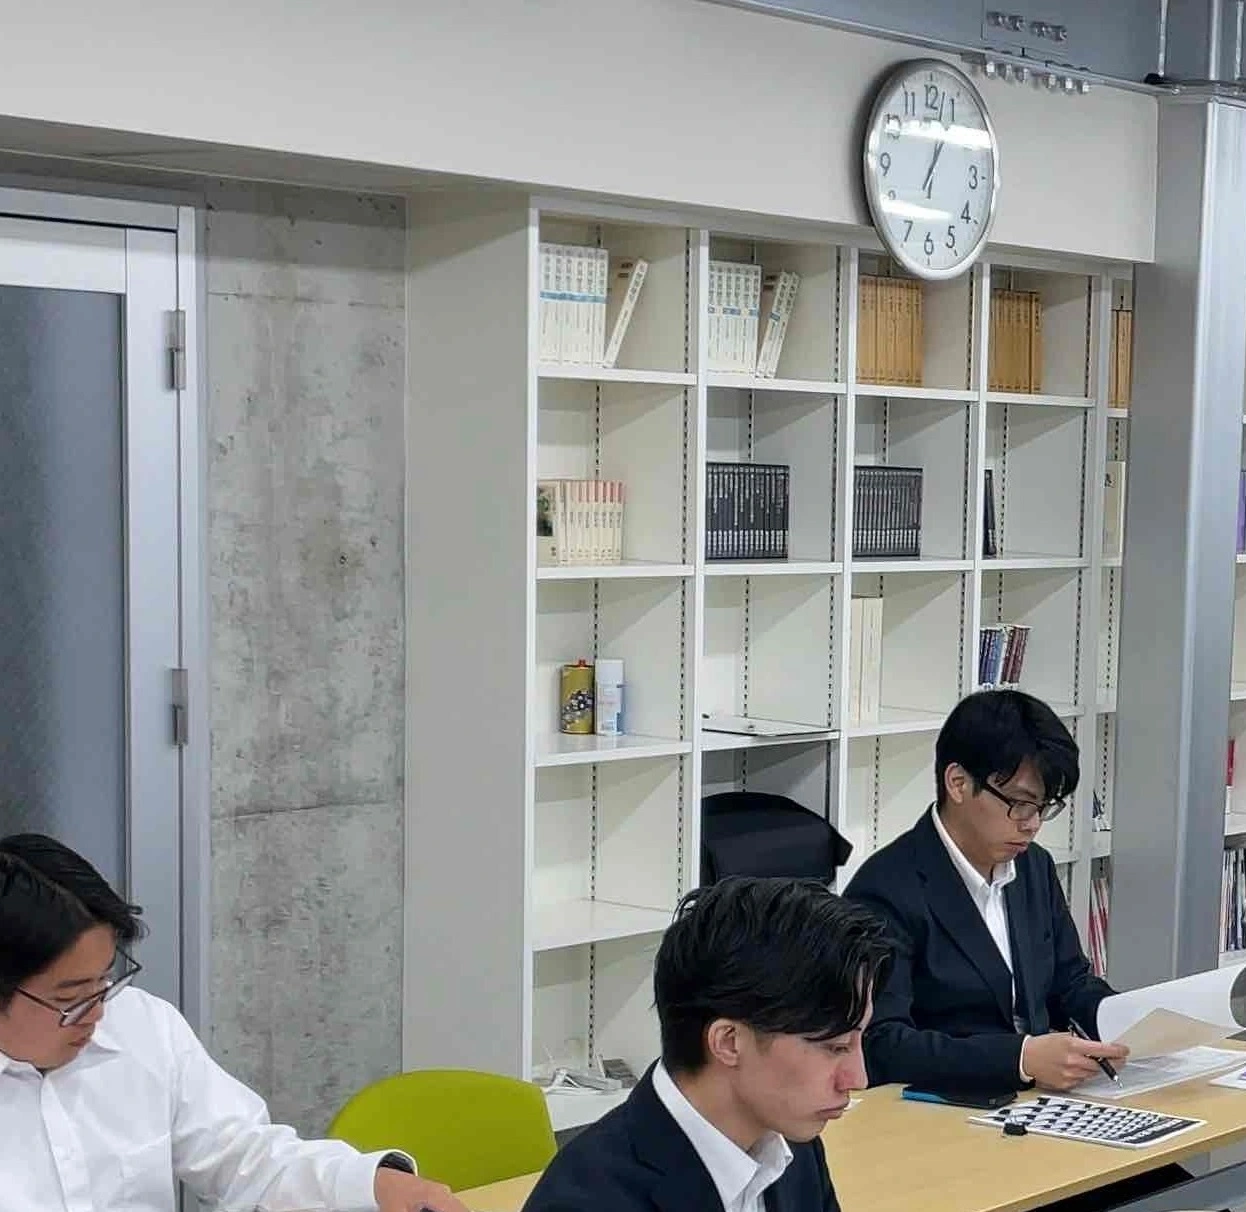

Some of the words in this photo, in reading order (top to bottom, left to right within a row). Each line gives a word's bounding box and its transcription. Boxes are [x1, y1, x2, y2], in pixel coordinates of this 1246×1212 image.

[904, 91, 915, 116] 11
[924, 84, 938, 110] 12
[949, 98, 955, 122] 1
[880, 152, 891, 176] 9
[969, 165, 978, 190] 3
[961, 200, 971, 224] 4
[903, 220, 913, 242] 7
[946, 225, 955, 249] 5
[924, 232, 934, 255] 6
